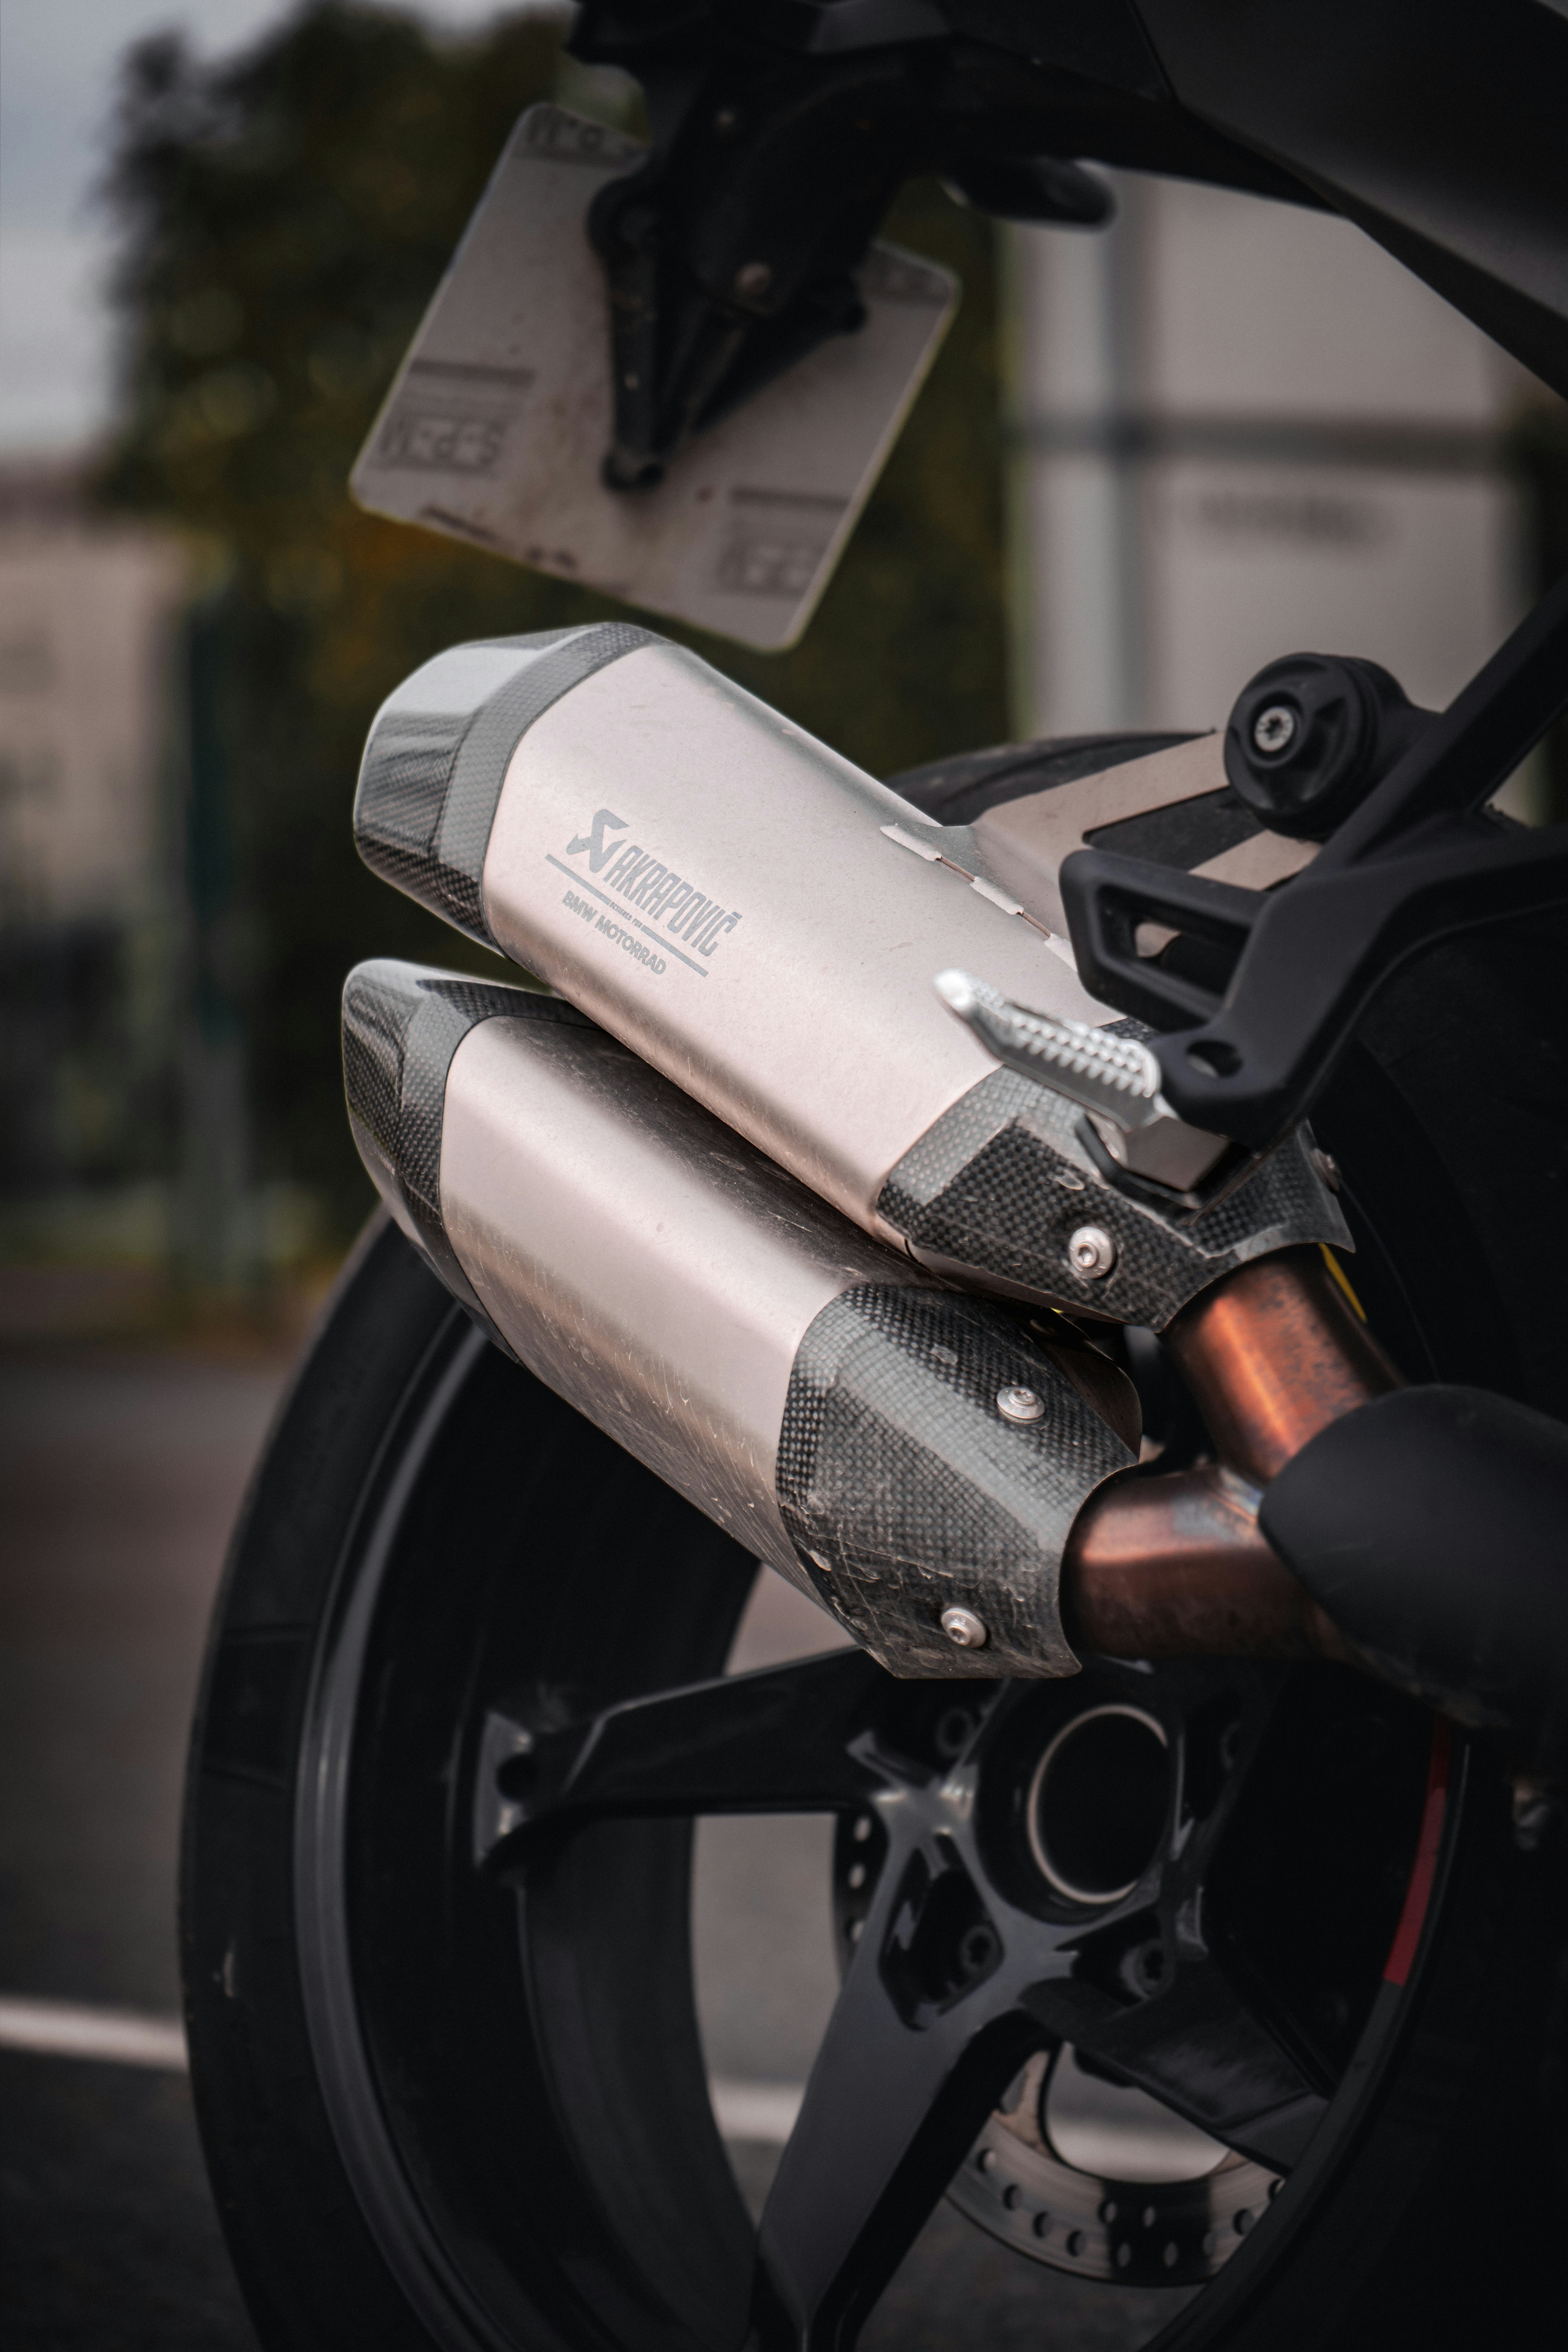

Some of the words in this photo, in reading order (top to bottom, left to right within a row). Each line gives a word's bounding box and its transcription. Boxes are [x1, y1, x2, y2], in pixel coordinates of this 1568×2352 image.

[562, 890, 598, 922] BMW
[594, 915, 666, 975] MOTORRAD
[632, 918, 642, 928] FOR
